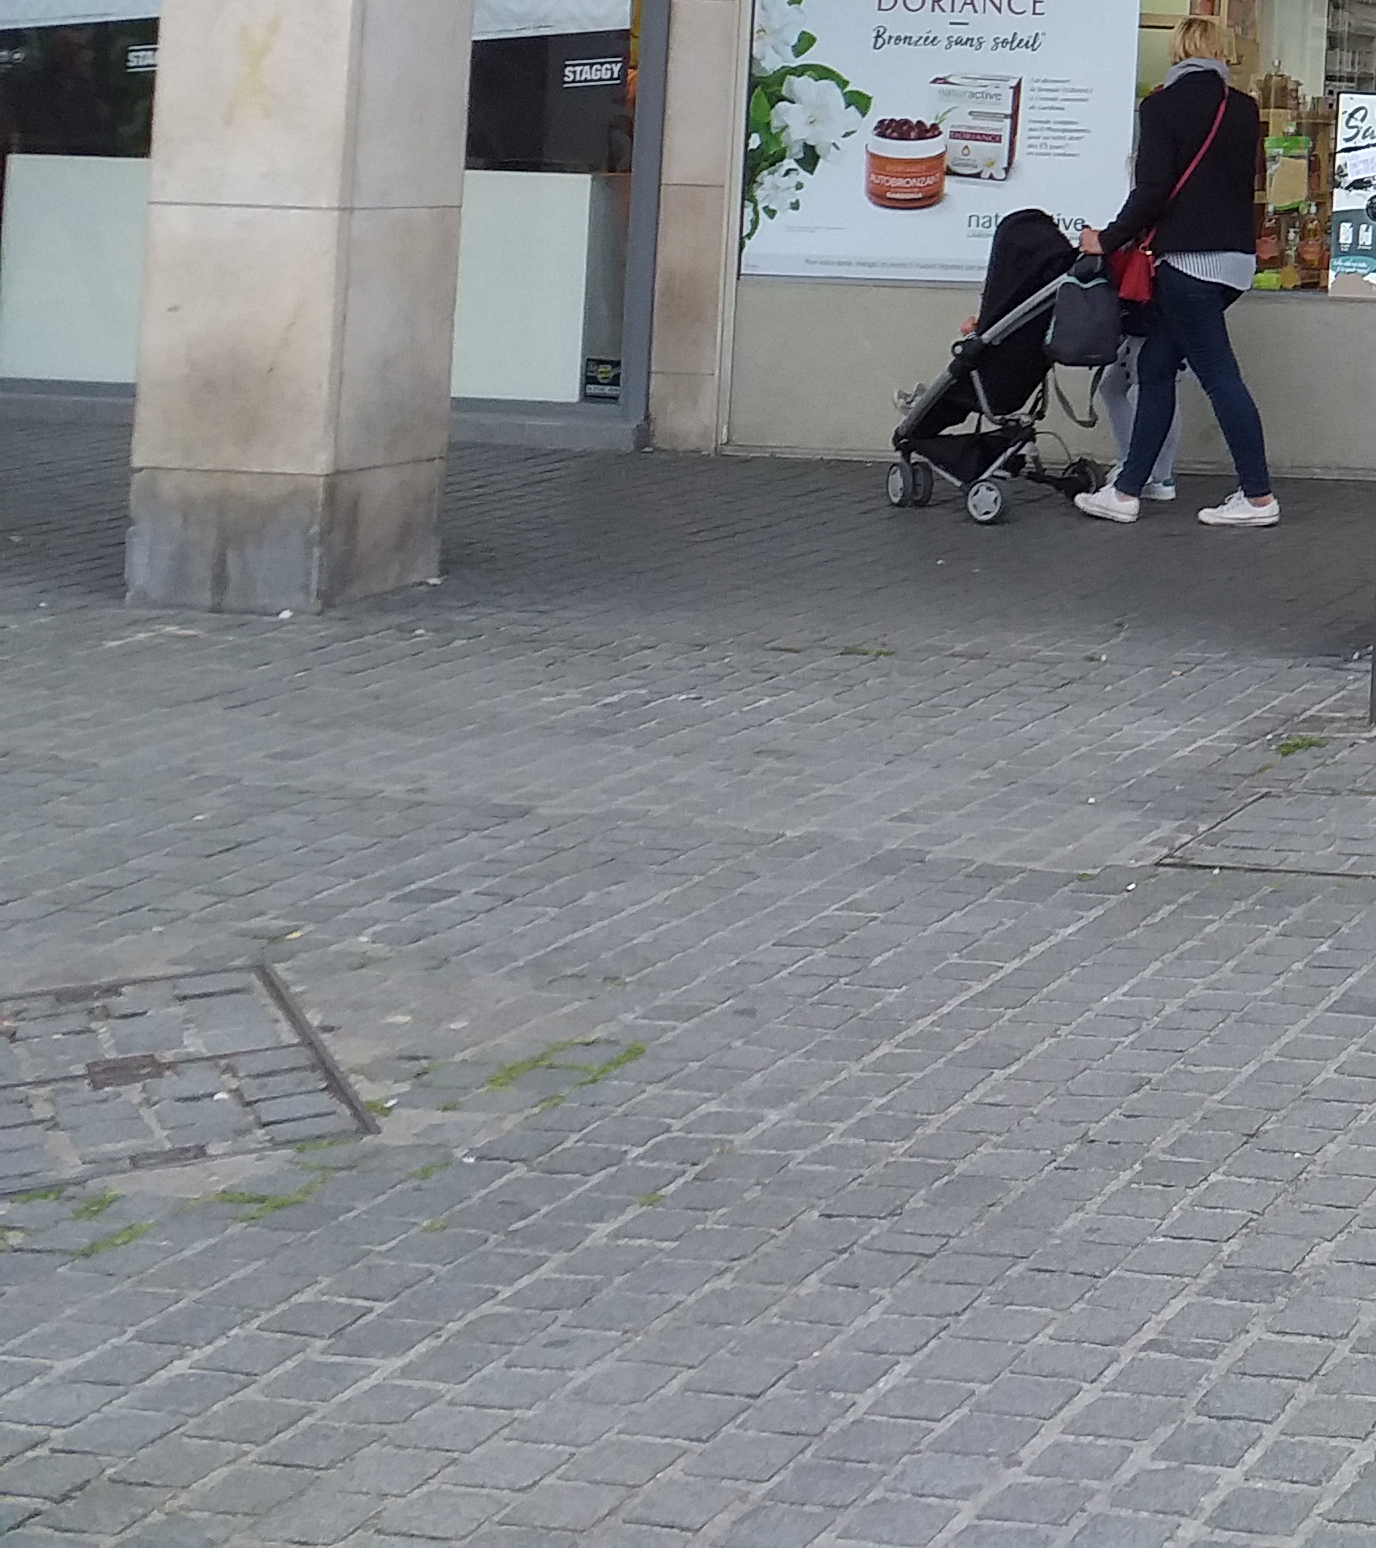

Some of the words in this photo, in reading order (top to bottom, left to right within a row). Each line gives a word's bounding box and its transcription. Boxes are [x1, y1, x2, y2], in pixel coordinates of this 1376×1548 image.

[872, 25, 942, 50] Bronzée
[944, 34, 987, 51] sans
[563, 63, 622, 82] STAGGY
